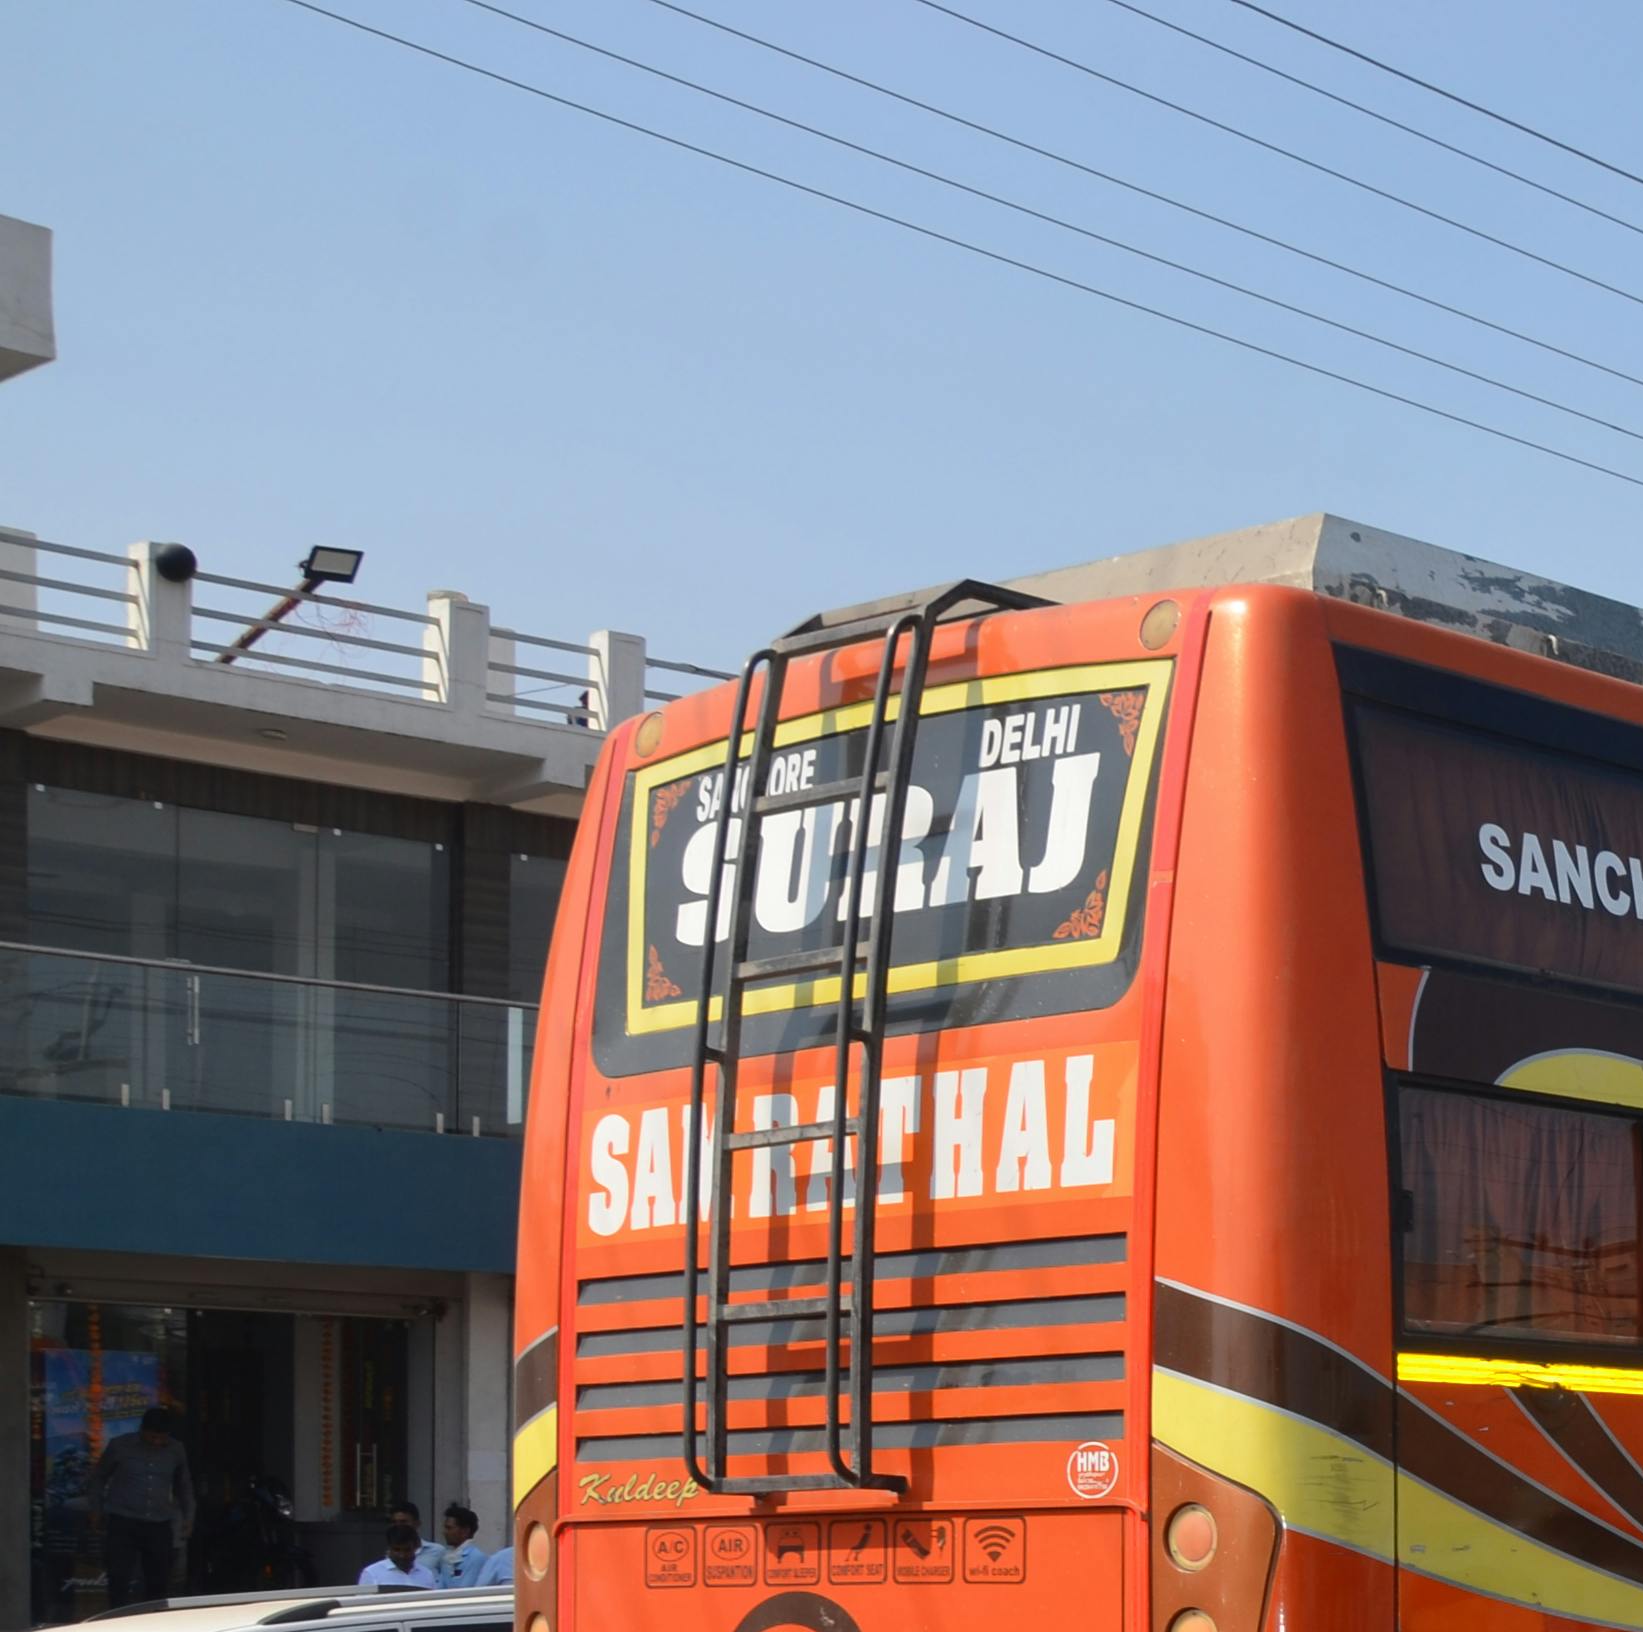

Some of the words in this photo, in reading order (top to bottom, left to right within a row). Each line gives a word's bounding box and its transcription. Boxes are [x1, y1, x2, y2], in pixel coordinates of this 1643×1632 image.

[979, 704, 1081, 768] DELHI
[676, 752, 1100, 947] SURAJ
[1077, 1450, 1110, 1472] HMB
[579, 1472, 700, 1507] Kuldeep
[718, 1538, 744, 1553] AIR
[991, 1566, 1020, 1577] coach
